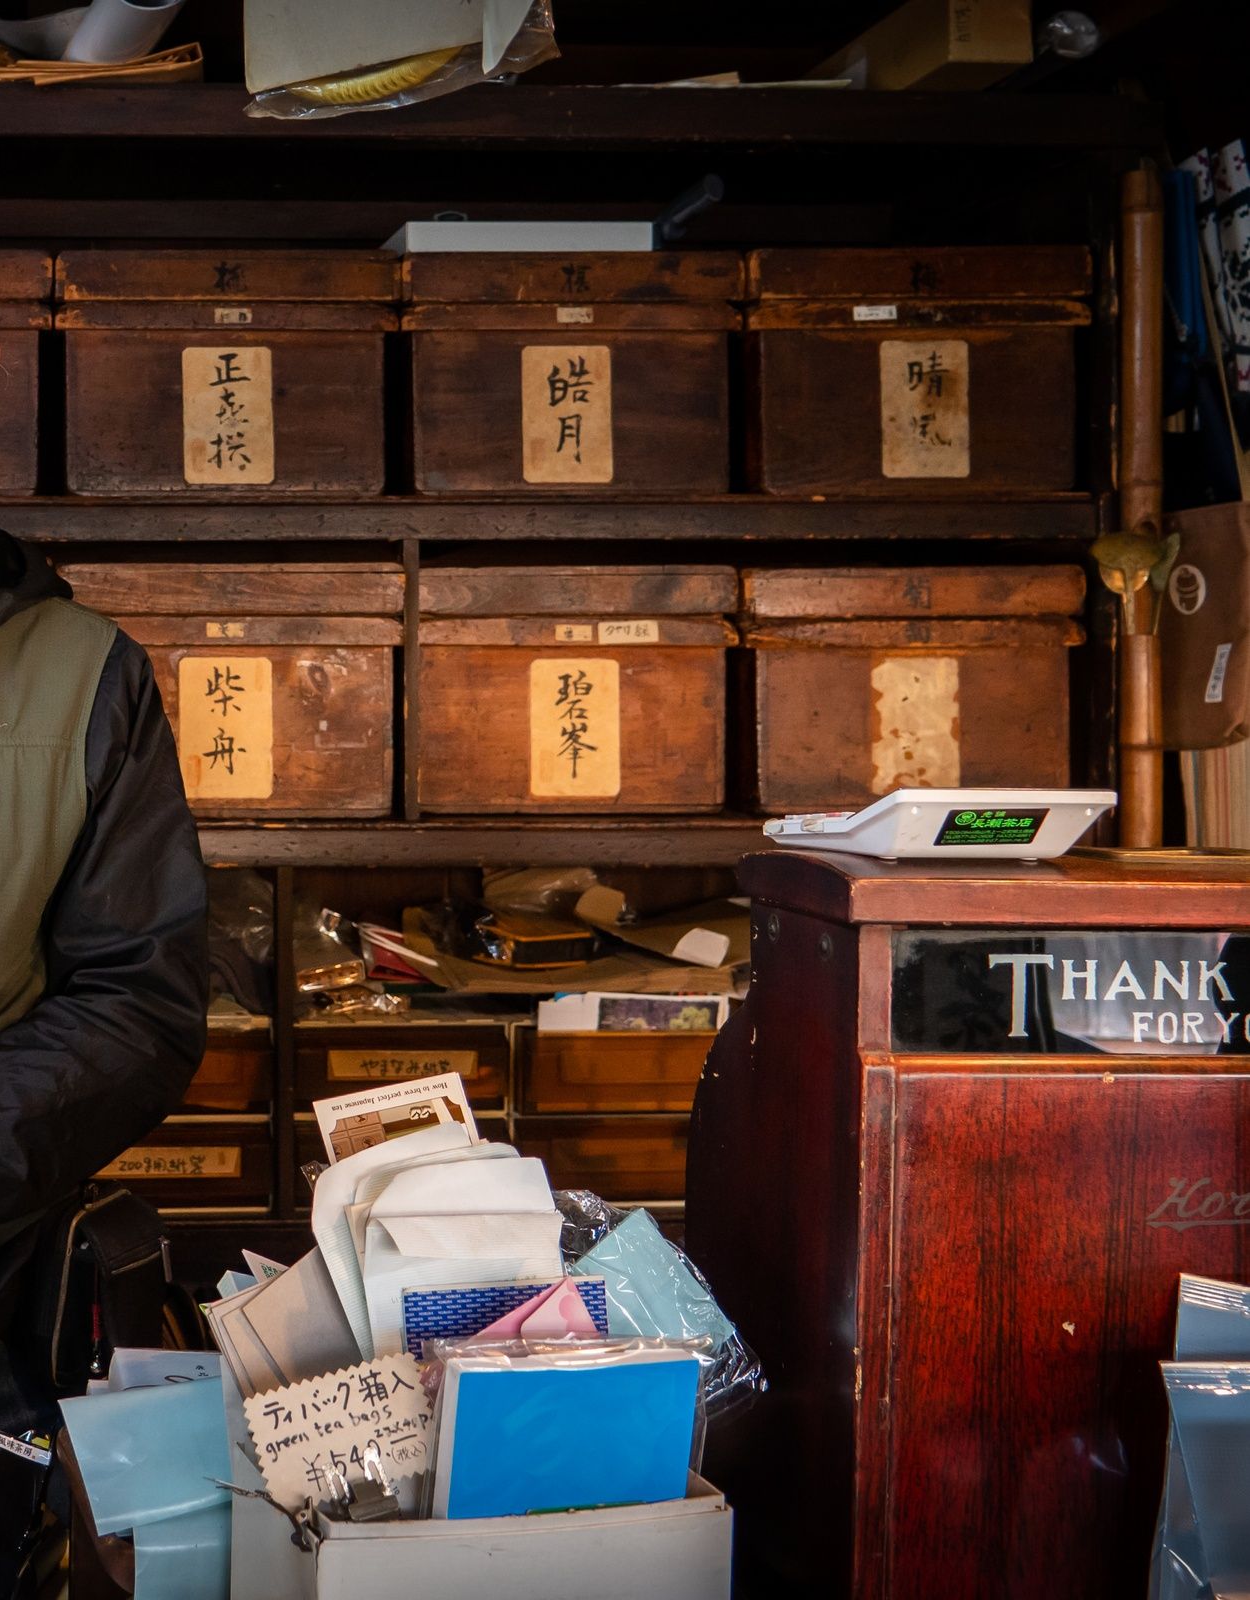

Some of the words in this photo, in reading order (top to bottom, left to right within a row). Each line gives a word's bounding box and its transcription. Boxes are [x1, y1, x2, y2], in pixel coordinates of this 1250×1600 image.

[988, 953, 1235, 1038] THANK
[1133, 1011, 1205, 1043] FOR
[1214, 1012, 1250, 1043] Y
[423, 1085, 430, 1093] to
[431, 1081, 448, 1091] How
[377, 1090, 402, 1103] perfect
[404, 1087, 422, 1097] brew
[331, 1103, 343, 1111] tea
[344, 1097, 375, 1108] Japanese
[266, 1431, 310, 1463] green
[314, 1420, 344, 1437] tea
[349, 1405, 393, 1427] bags
